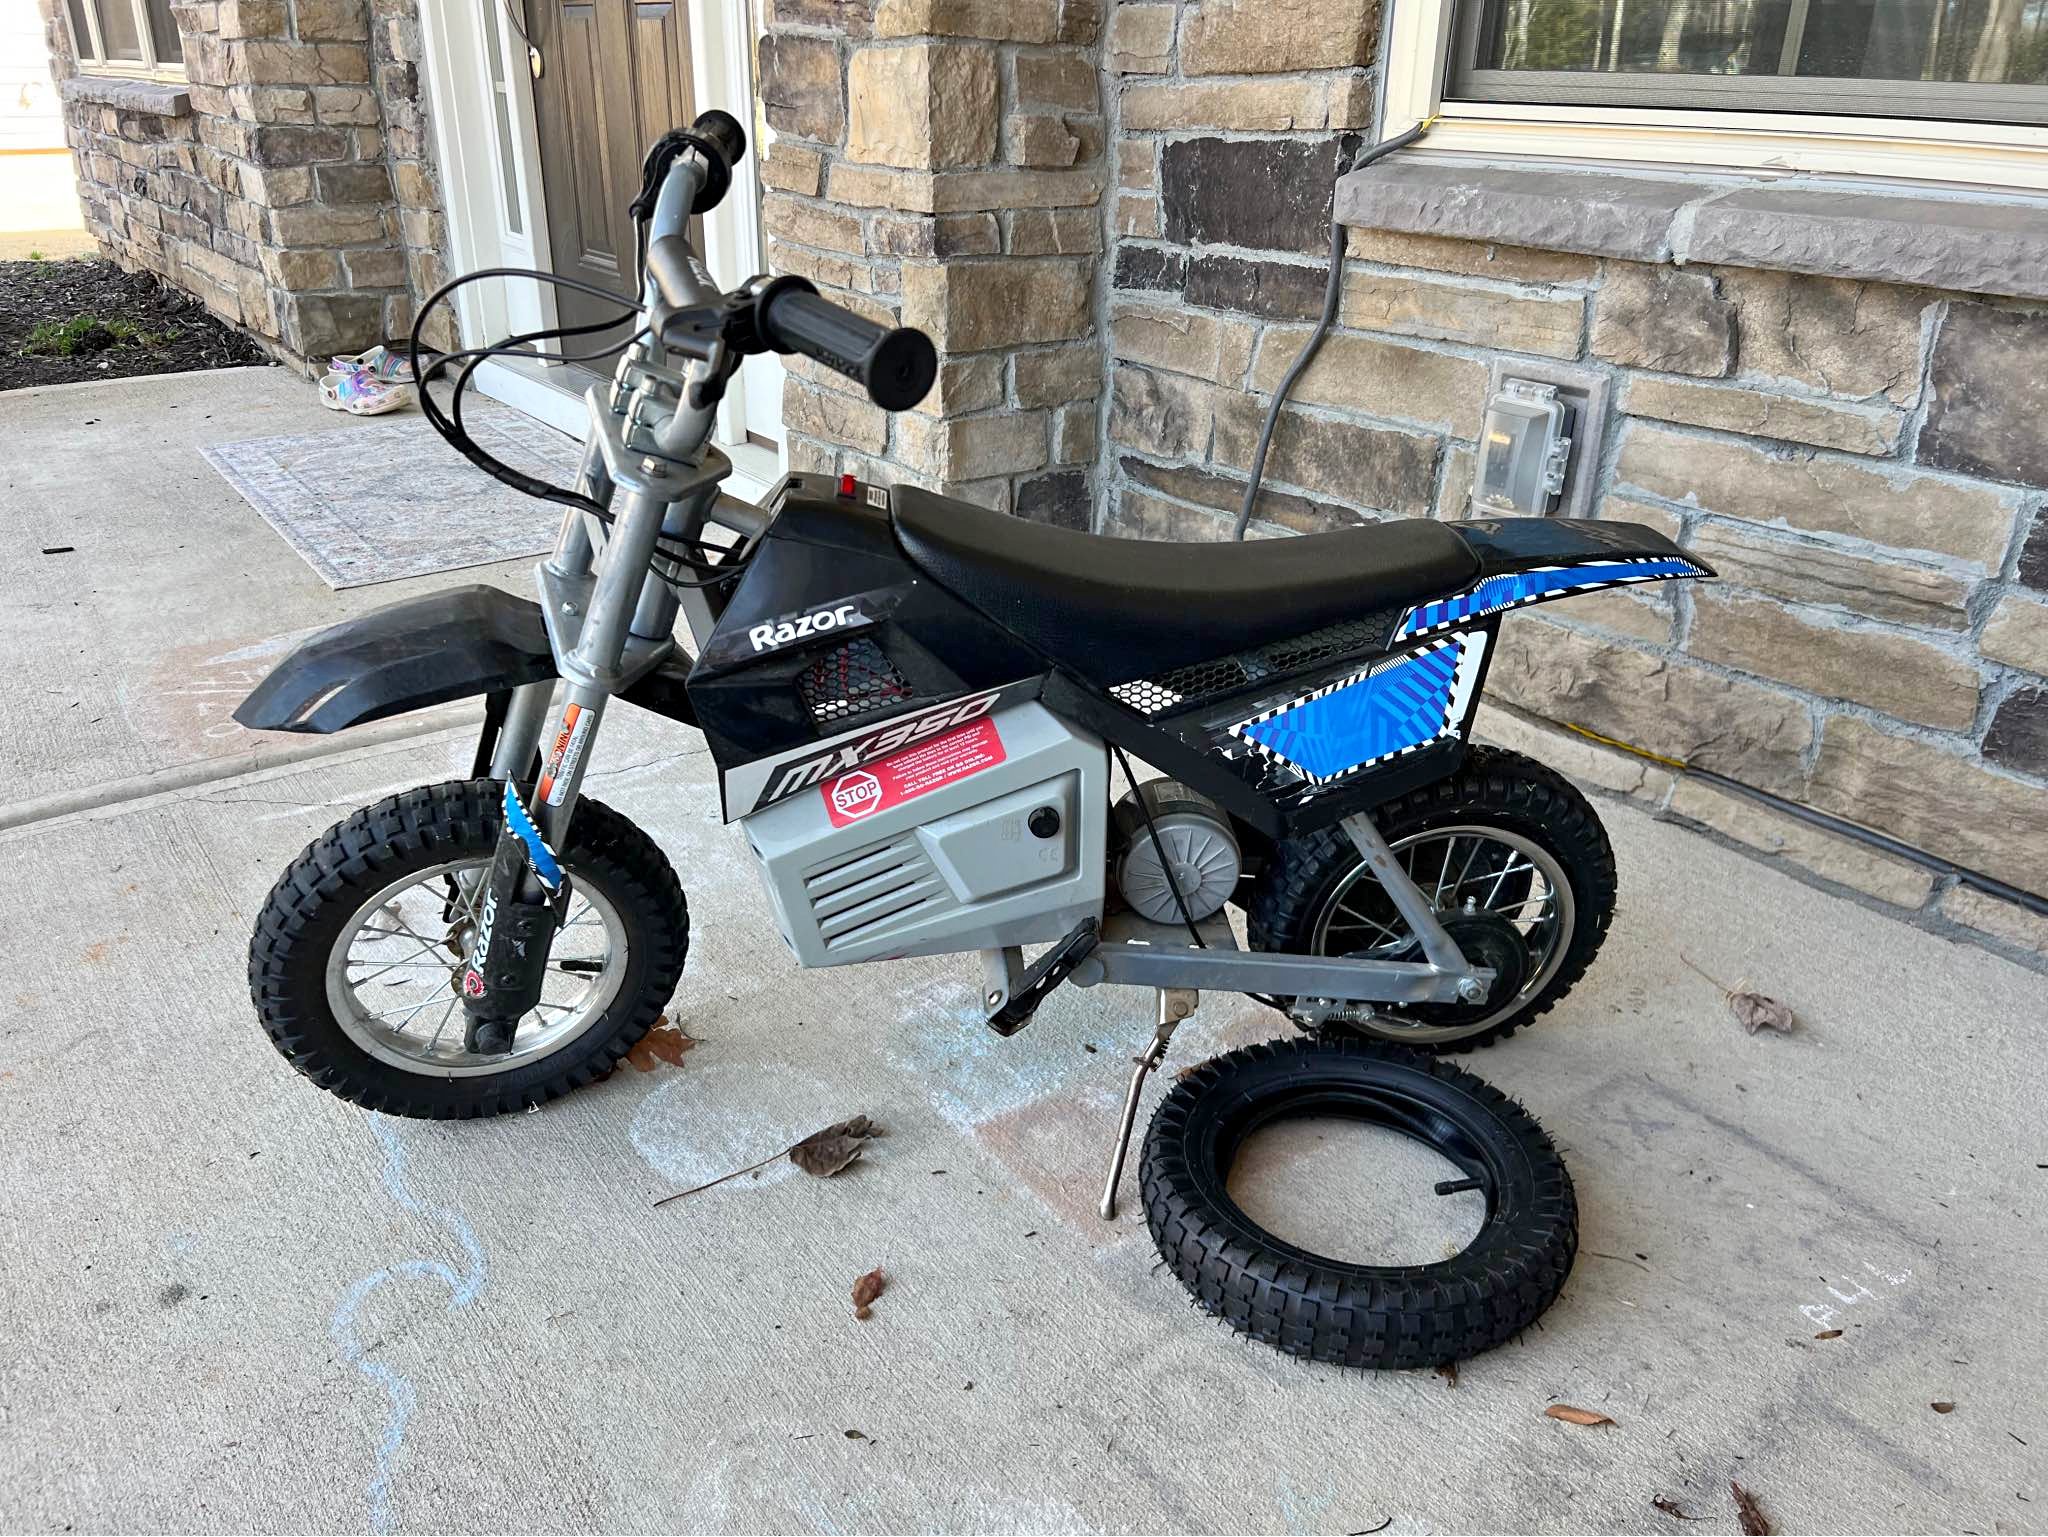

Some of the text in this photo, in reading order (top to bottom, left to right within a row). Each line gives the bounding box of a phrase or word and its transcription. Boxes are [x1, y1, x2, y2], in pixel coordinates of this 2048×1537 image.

[749, 605, 855, 652] Razor
[768, 692, 1000, 803] MX350
[836, 780, 878, 808] STOP
[903, 779, 917, 789] CALL
[917, 773, 931, 783] TOLL
[932, 768, 946, 777] FREE
[472, 887, 498, 975] Razor
